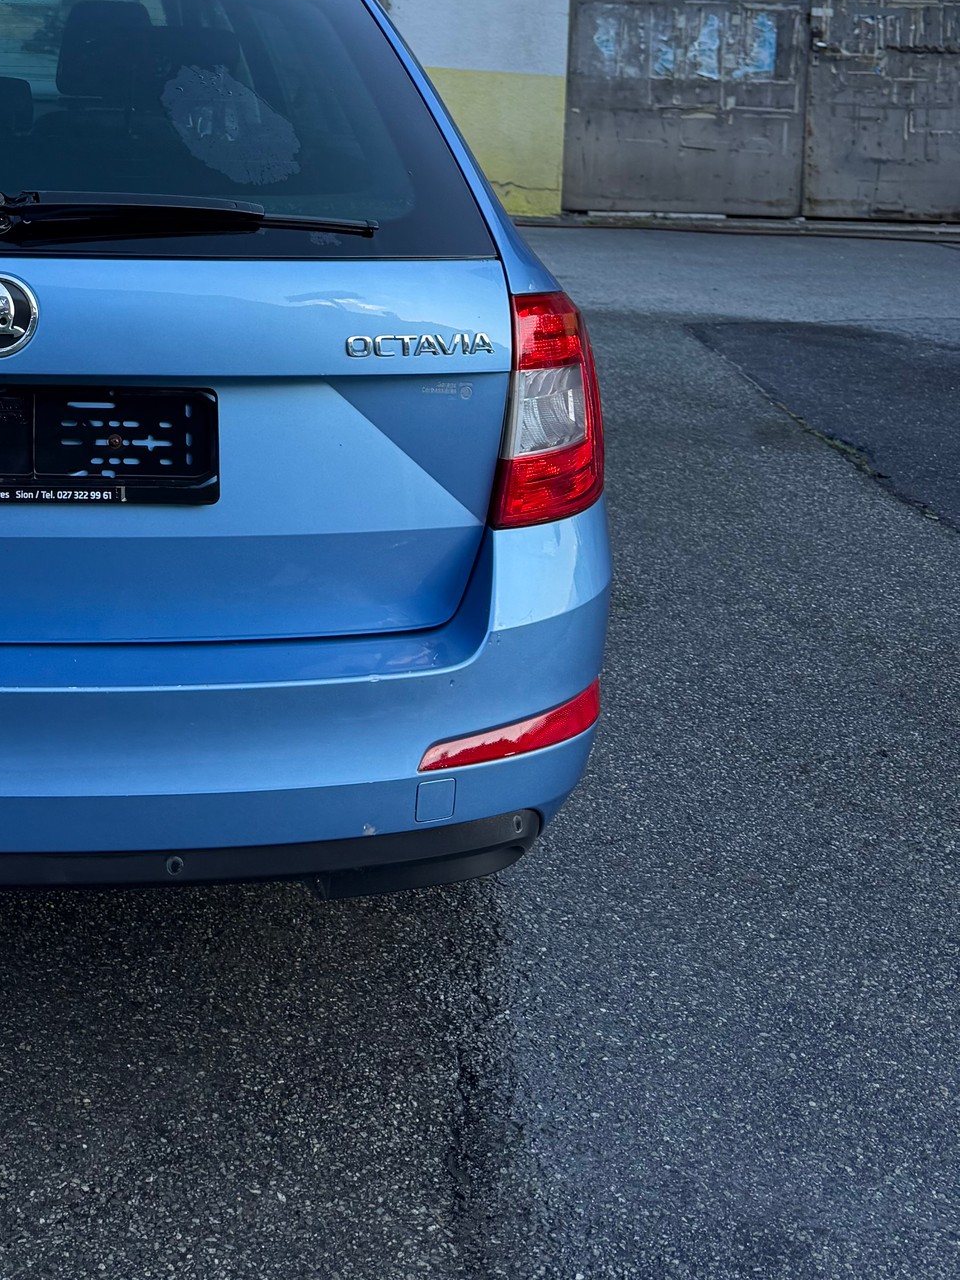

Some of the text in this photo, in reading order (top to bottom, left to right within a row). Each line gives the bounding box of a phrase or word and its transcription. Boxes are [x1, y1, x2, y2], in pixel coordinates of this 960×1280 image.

[346, 332, 495, 358] OCTAVIA
[16, 490, 34, 499] Sion
[41, 490, 56, 499] Tel.
[57, 490, 73, 500] 027
[74, 490, 89, 500] 322
[90, 491, 102, 500] 99
[102, 491, 113, 500] 61
